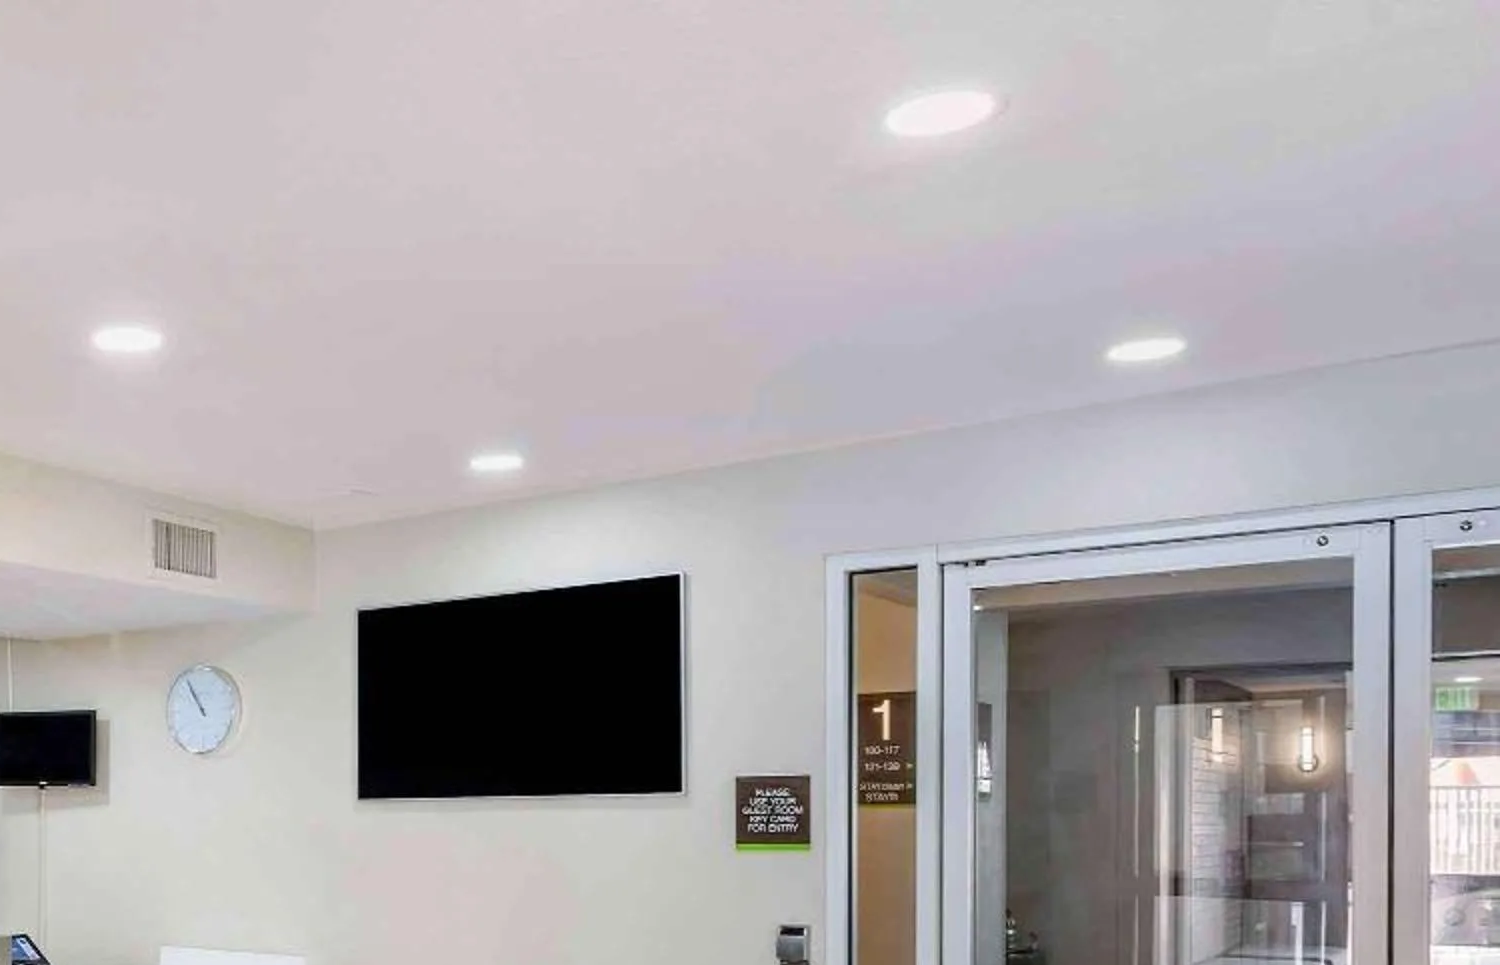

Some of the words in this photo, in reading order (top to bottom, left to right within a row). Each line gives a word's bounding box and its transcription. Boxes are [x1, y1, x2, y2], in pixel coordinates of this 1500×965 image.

[872, 699, 891, 741] 1
[755, 787, 791, 797] PLEASE
[769, 797, 797, 805] YOUR
[741, 805, 772, 815] GUEST
[775, 805, 804, 815] ROOM
[769, 815, 797, 823] CARD
[747, 823, 767, 833] FOR
[767, 823, 800, 833] ENTRY
